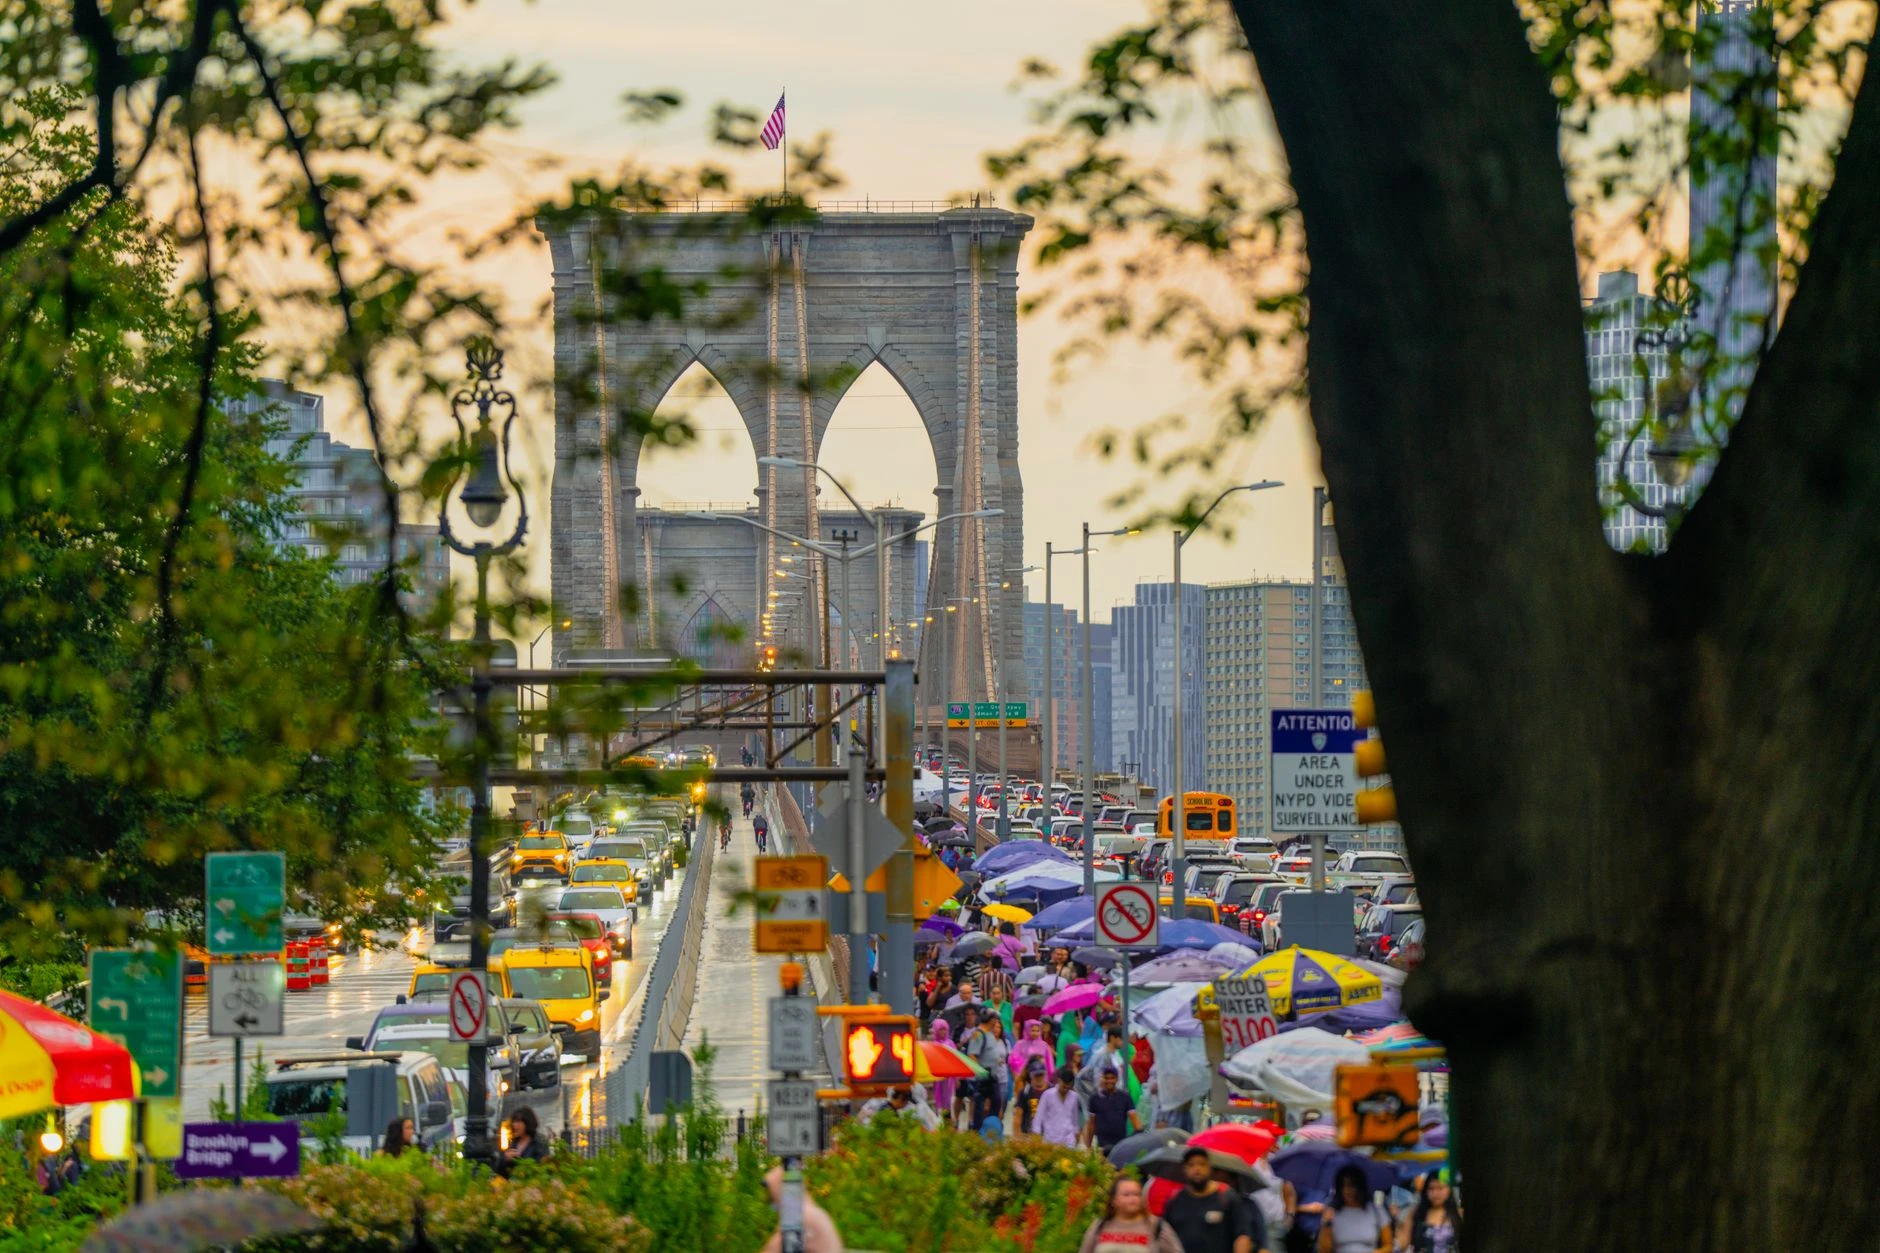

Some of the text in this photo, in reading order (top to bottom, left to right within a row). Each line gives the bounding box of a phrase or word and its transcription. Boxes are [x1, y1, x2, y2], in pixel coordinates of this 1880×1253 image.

[1299, 756, 1340, 769] AREA
[1295, 775, 1344, 788] UNDER
[1275, 793, 1355, 807] NYPD VIDE
[1276, 811, 1358, 826] SURVEILLANC
[231, 967, 260, 983] ALL
[1228, 979, 1265, 995] COLD
[891, 1032, 914, 1076] 4
[187, 1133, 249, 1152] Brooklyn
[187, 1149, 233, 1168] Bridge
